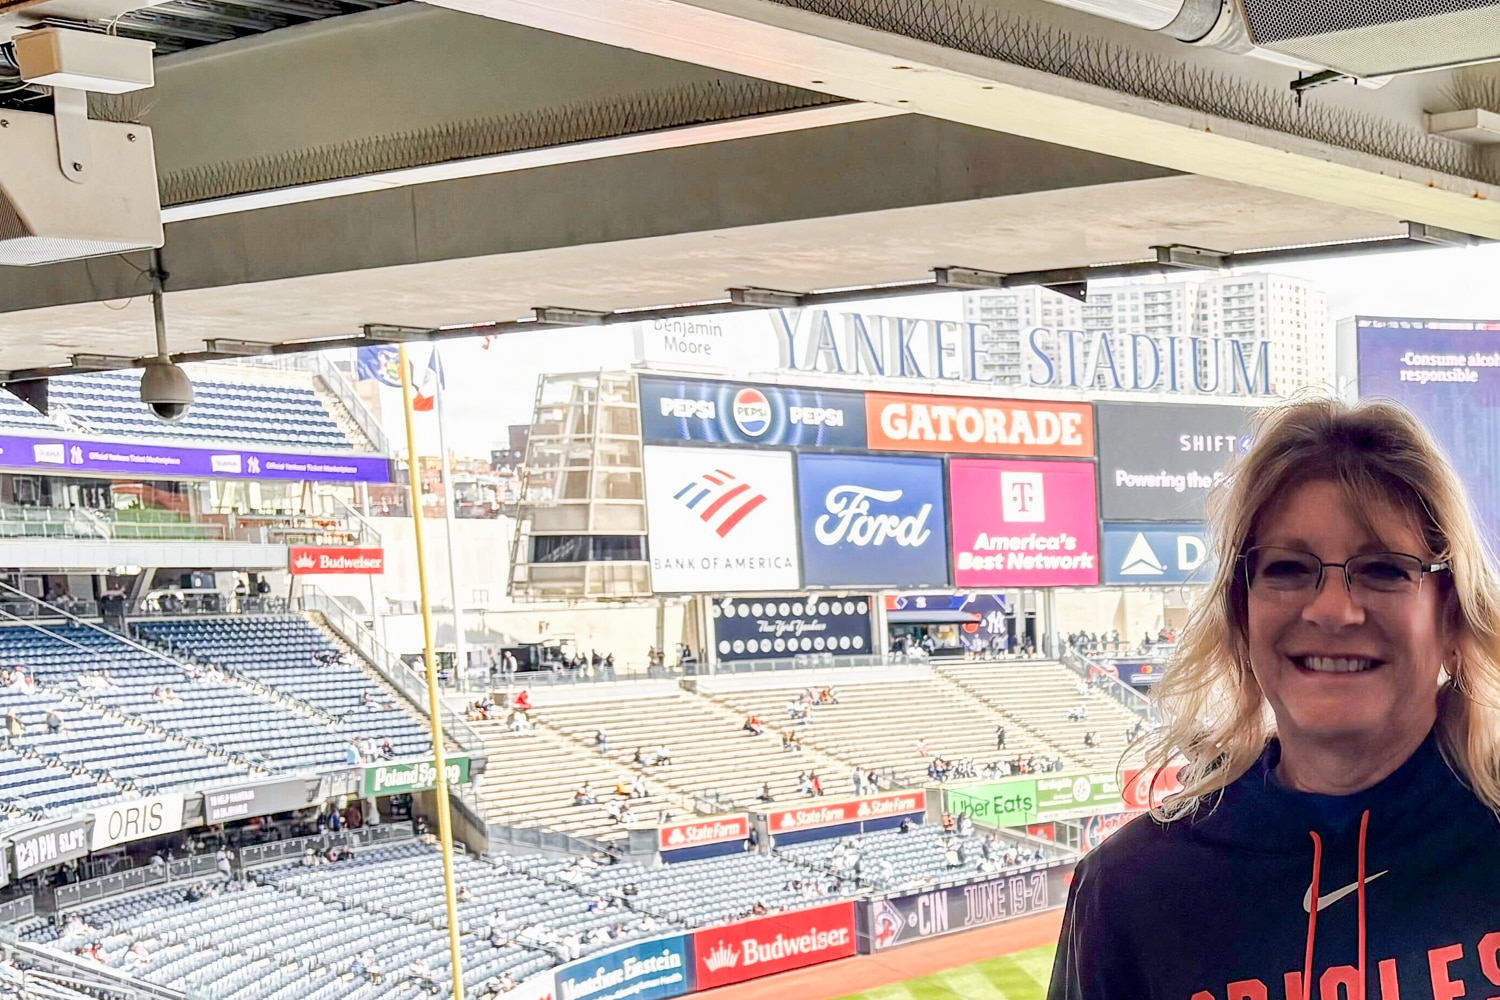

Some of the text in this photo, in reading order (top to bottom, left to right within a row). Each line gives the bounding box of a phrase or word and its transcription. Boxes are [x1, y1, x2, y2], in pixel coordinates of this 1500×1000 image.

[654, 319, 722, 337] Benjamin
[664, 336, 711, 355] Moore
[772, 308, 1272, 395] YANKEE STADIUM
[1400, 369, 1478, 384] responsible
[660, 398, 716, 419] PEPSI
[737, 406, 767, 417] PEPSI
[790, 407, 844, 426] PEPSI
[880, 403, 1083, 446] GATORADE
[1115, 470, 1185, 492] Powering
[1187, 470, 1212, 488] the
[815, 484, 932, 547] Ford
[973, 532, 1077, 551] America's
[319, 554, 382, 571] Budweiser
[654, 557, 793, 570] BANK OF AMERICA
[957, 552, 1095, 570] Best Network
[374, 762, 460, 791] Poland Spng
[953, 799, 988, 818] Uber
[993, 795, 1032, 815] Eats
[108, 802, 163, 840] ORIS
[917, 870, 1048, 935] CIN JUNE 19-21
[741, 926, 849, 967] Budweiser
